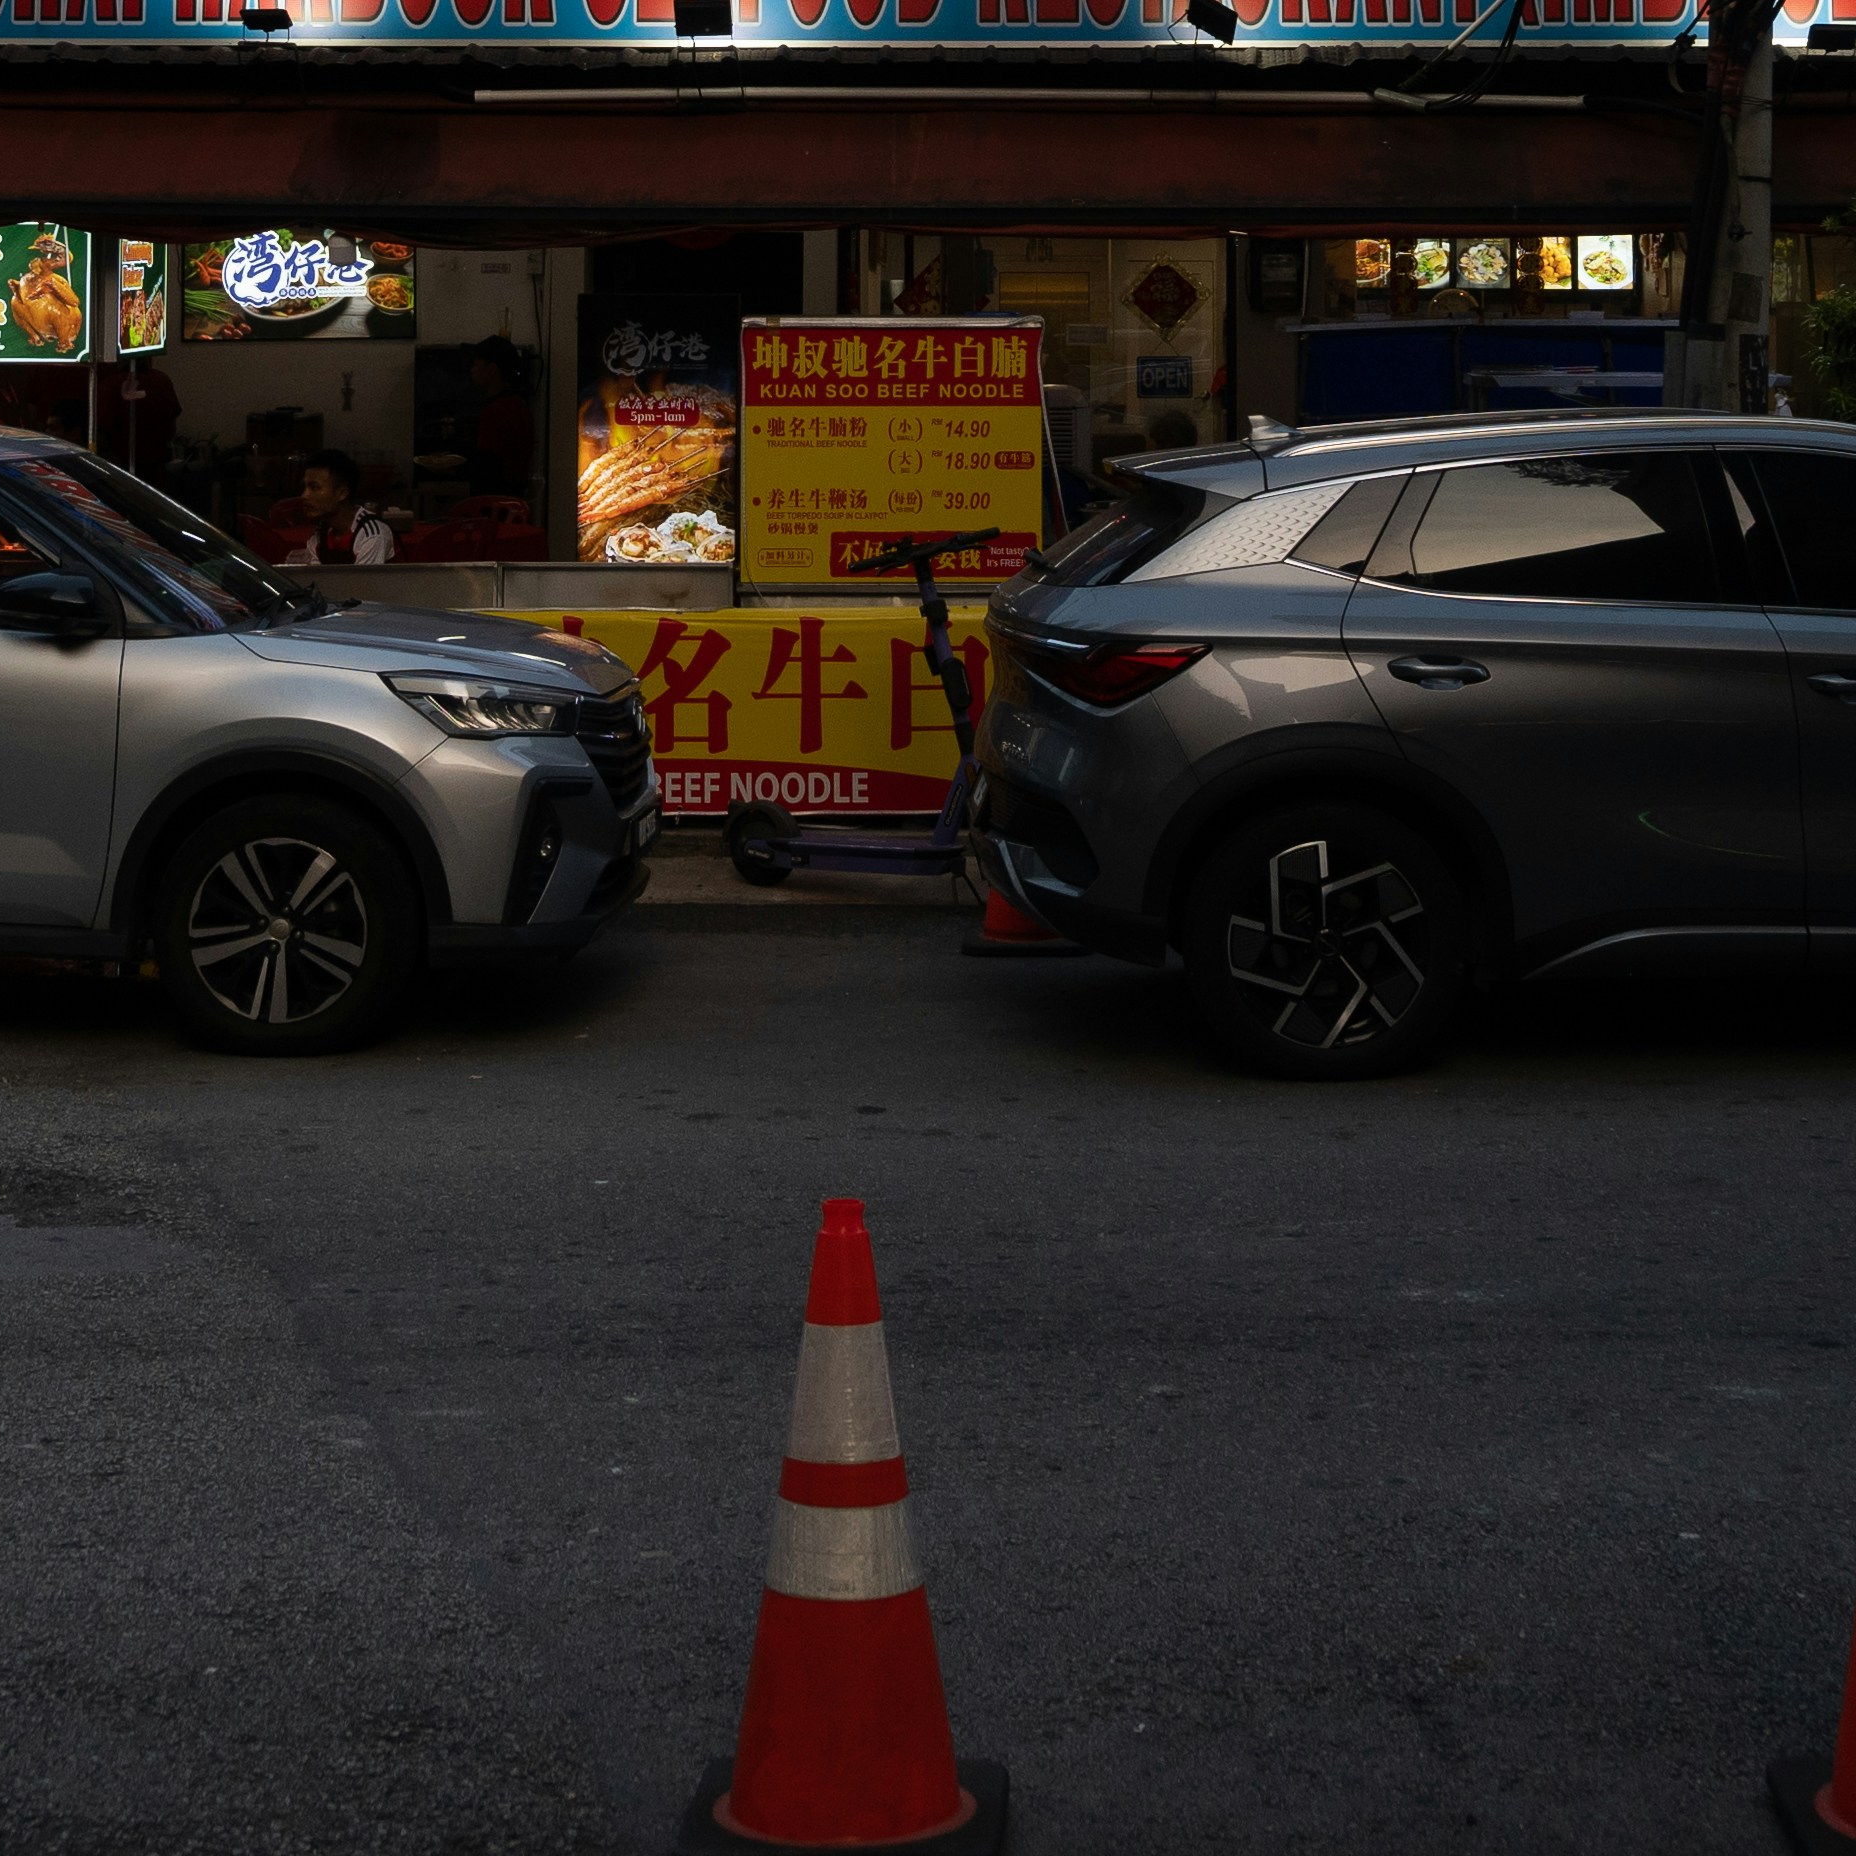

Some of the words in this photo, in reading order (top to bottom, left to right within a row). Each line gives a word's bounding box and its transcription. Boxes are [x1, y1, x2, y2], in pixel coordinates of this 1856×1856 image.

[752, 335, 1028, 380] 坤叔驰名牛白腩
[1143, 367, 1188, 389] OPEN
[760, 383, 817, 398] KUAN
[825, 383, 869, 398] SOO
[877, 383, 931, 398] BEEF
[939, 383, 1024, 398] NOODLE
[630, 411, 686, 422] 5pm-1am
[945, 420, 991, 438] 14.90
[766, 440, 815, 448] TRADITIONAL
[815, 440, 835, 448] BEEF
[837, 440, 867, 448] NOODLE
[945, 452, 991, 470] 18.90
[944, 492, 991, 510] 39.00
[766, 512, 785, 520] BEEF
[824, 512, 844, 520] SOUP
[854, 512, 888, 520] CLAYPOT
[729, 771, 870, 805] NOODLE
